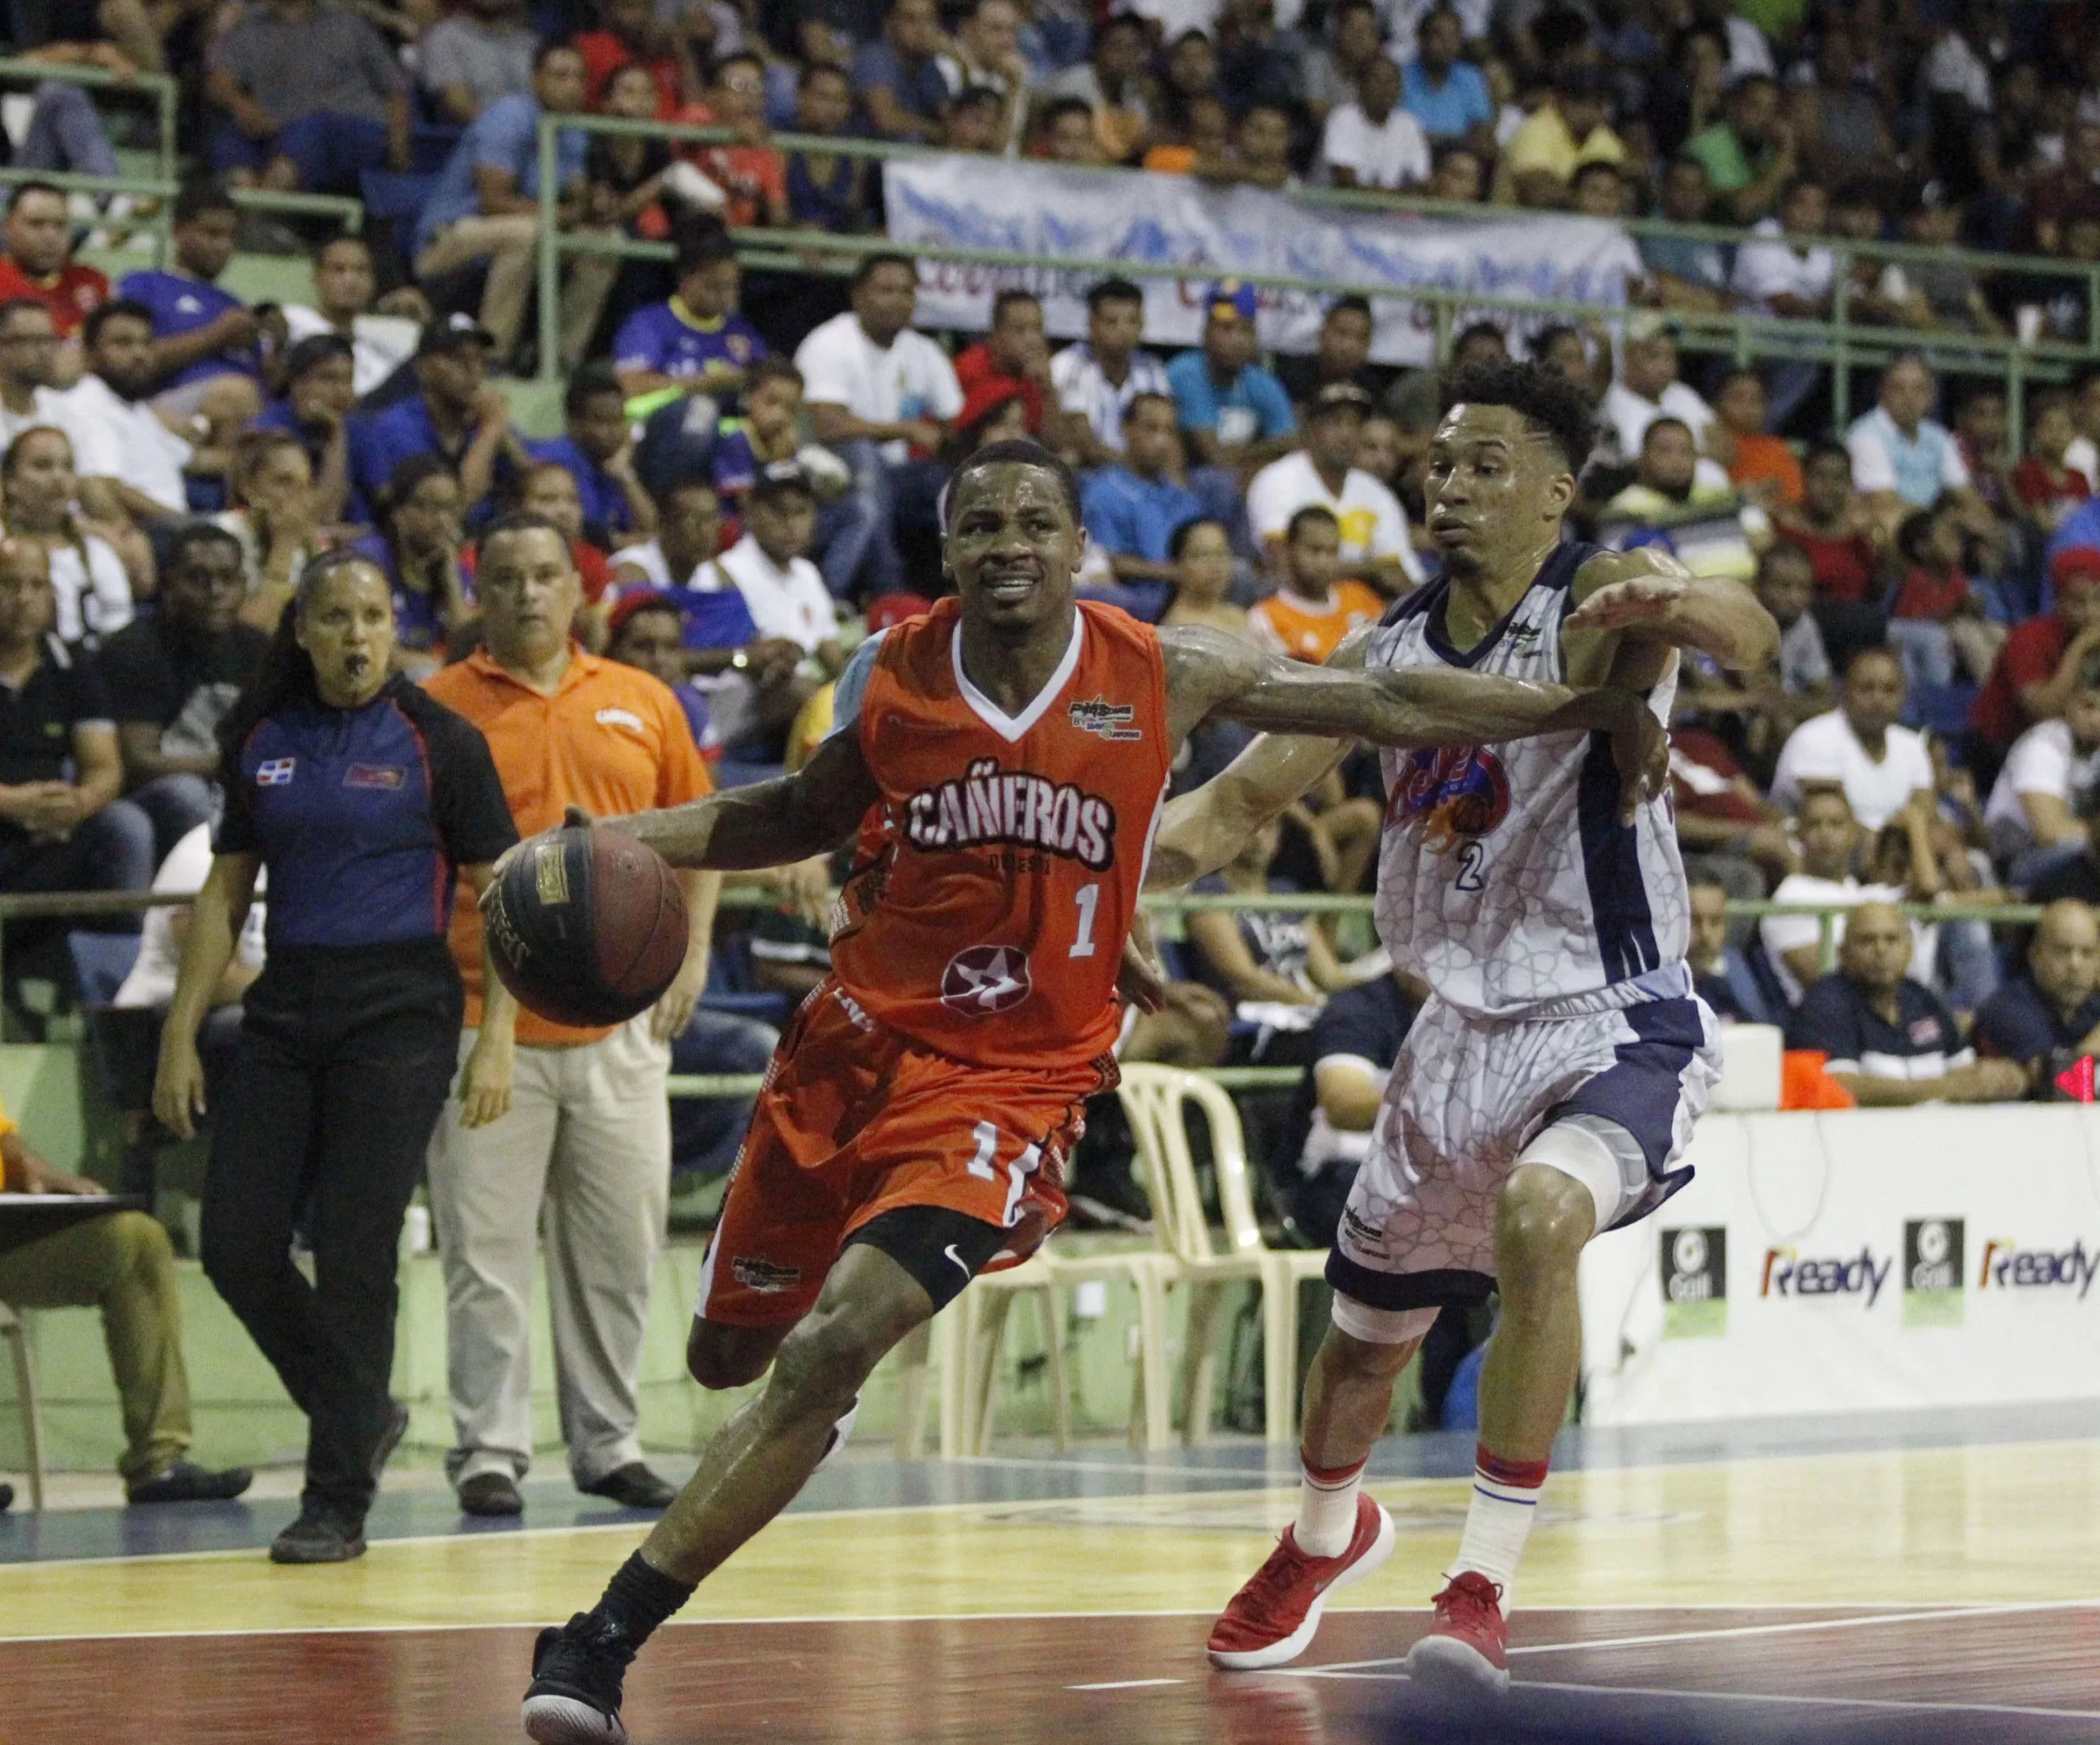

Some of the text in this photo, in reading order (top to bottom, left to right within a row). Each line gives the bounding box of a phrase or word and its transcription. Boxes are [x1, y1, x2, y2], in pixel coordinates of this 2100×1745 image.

[906, 758, 1112, 867] CAÑEROS
[1455, 840, 1484, 891] 2
[1069, 884, 1098, 958] 1
[1760, 1245, 1892, 1308] Ready
